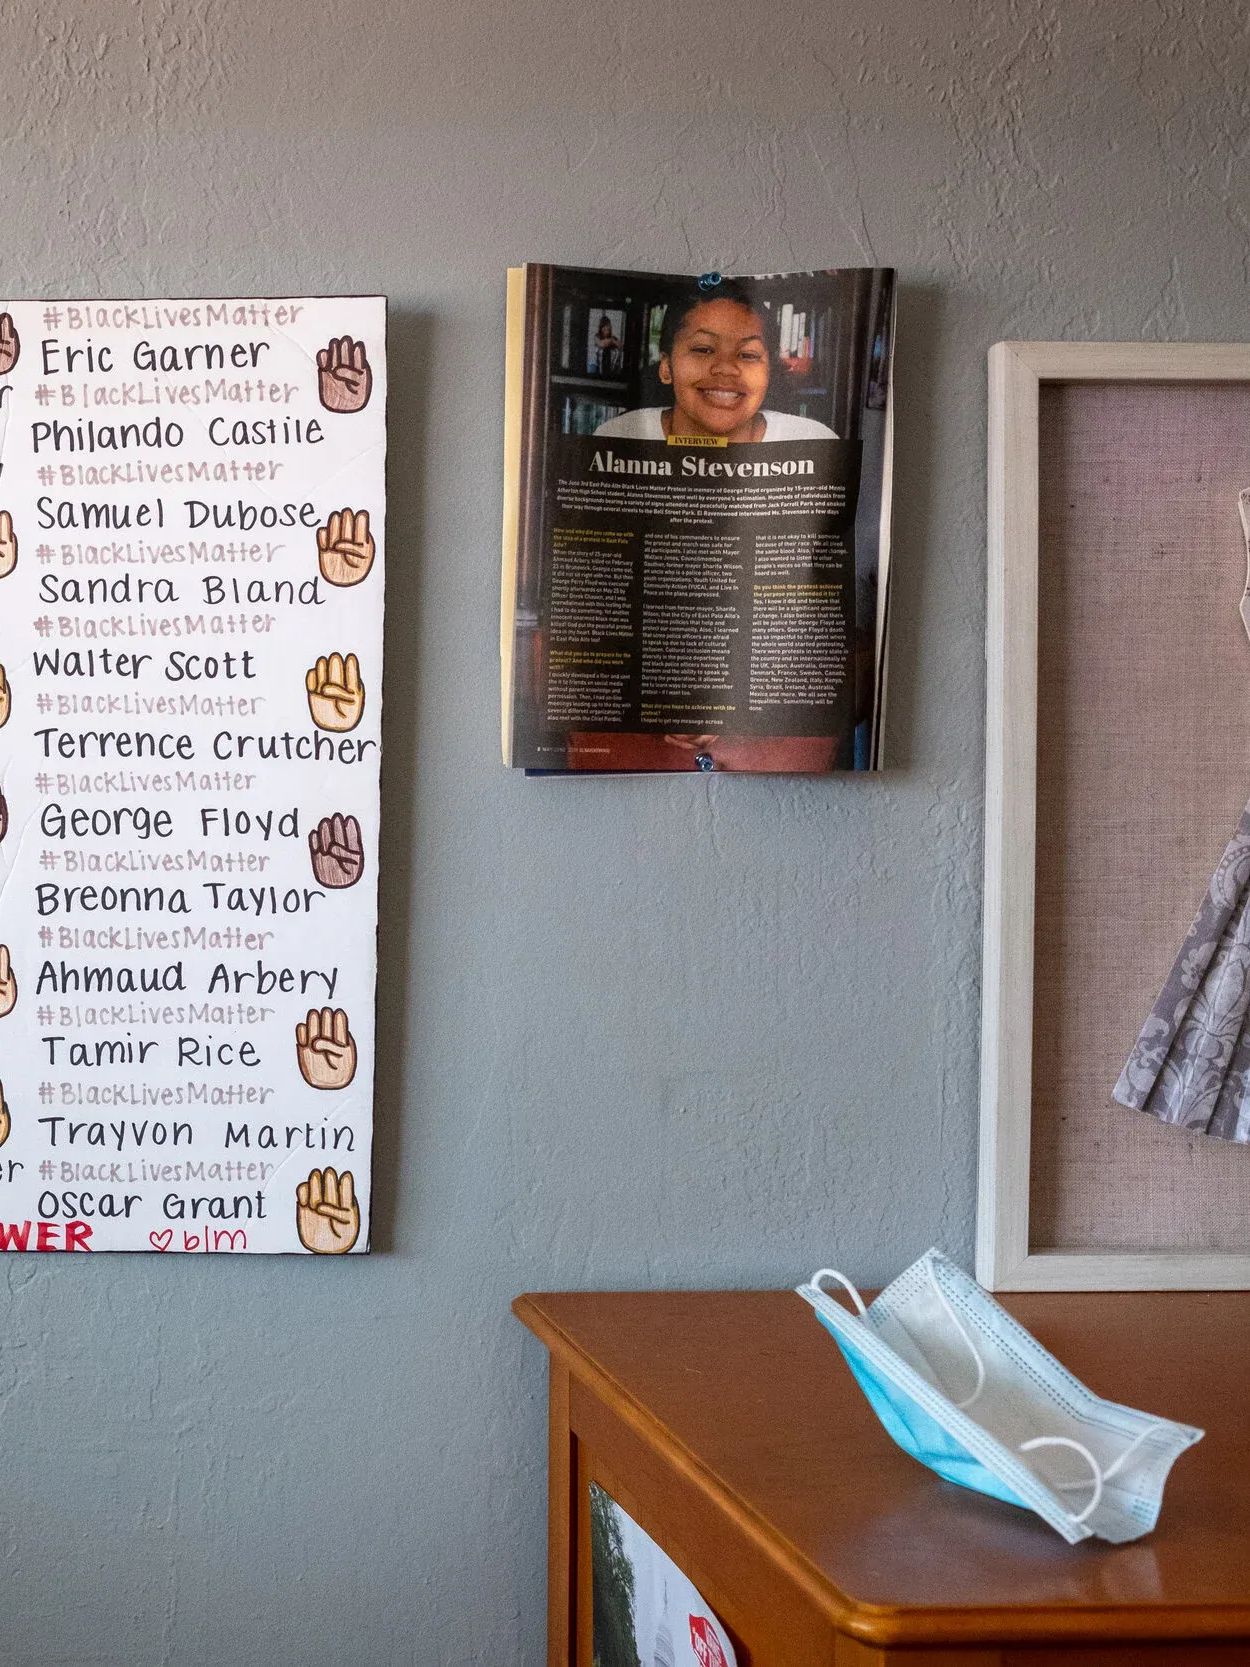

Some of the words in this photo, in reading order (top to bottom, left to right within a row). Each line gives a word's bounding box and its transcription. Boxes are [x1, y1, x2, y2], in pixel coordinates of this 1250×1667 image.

[43, 303, 303, 331] #BlackLivesMatter
[42, 339, 113, 375] Eric
[134, 341, 269, 371] Garner
[31, 417, 183, 453] Philando
[209, 416, 324, 446] Castile
[674, 436, 719, 445] INTERVIEW
[37, 460, 283, 486] #BlackLivesMatter
[589, 451, 673, 476] Alanna
[681, 456, 815, 478] Stevenson
[37, 497, 163, 529] Samuel
[184, 500, 321, 530] Dubose
[39, 573, 179, 604] Sandra
[203, 574, 326, 605] Bland
[33, 613, 276, 638] #BlackLivesMatter
[33, 648, 152, 679] Walter
[165, 651, 256, 681] Scott
[34, 728, 194, 760] Terrence
[212, 729, 377, 764] Crutcher
[35, 771, 256, 795] #BlackLivesMatter
[41, 804, 173, 839] George
[201, 808, 299, 841] Floyd
[35, 883, 191, 915] Breonna
[209, 882, 327, 915] Taylor
[36, 961, 186, 994] Ahmaud
[208, 960, 337, 999] Arbery
[37, 1001, 275, 1027] #BlackLivesMatter
[42, 1037, 158, 1066] Tamir
[179, 1037, 260, 1066] Rice
[38, 1117, 192, 1151] Trayvon
[225, 1122, 354, 1151] Martin
[39, 1159, 274, 1183] #BlackLivesMatter
[38, 1191, 142, 1218] Oscar
[163, 1191, 266, 1219] Grant
[184, 1229, 243, 1250] blm
